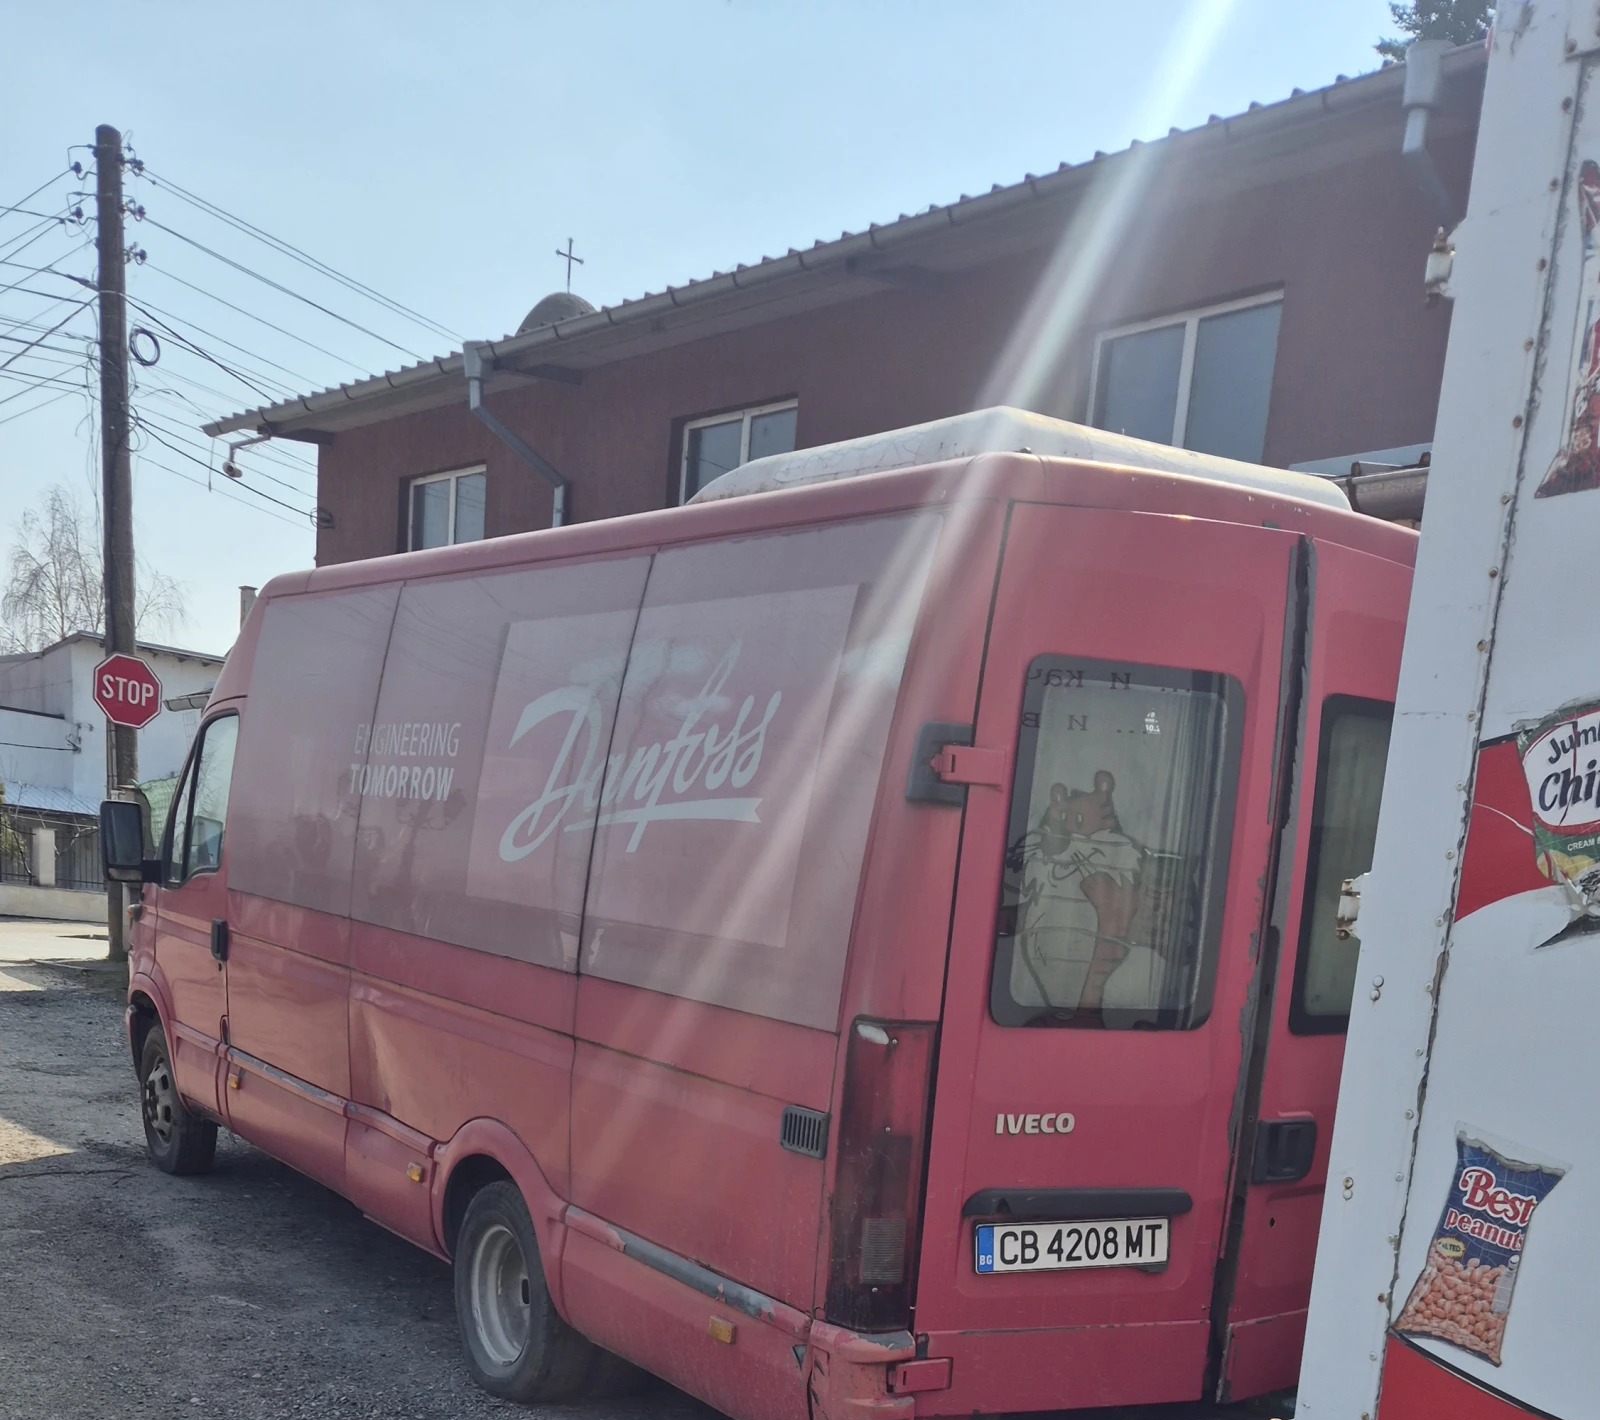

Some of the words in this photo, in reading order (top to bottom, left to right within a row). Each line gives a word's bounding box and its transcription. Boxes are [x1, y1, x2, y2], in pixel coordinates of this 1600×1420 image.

[102, 674, 154, 707] STOP
[353, 721, 462, 758] ENGINEERING
[499, 639, 783, 863] Danfoss
[1547, 721, 1600, 765] Jum
[349, 763, 455, 801] TOMORROW
[1567, 837, 1595, 852] CREAM
[995, 1112, 1076, 1135] IVECO
[1459, 1166, 1537, 1227] Best
[979, 1254, 993, 1266] BG
[999, 1229, 1040, 1265] CB
[1047, 1226, 1119, 1263] 4208
[1125, 1223, 1163, 1259] MT
